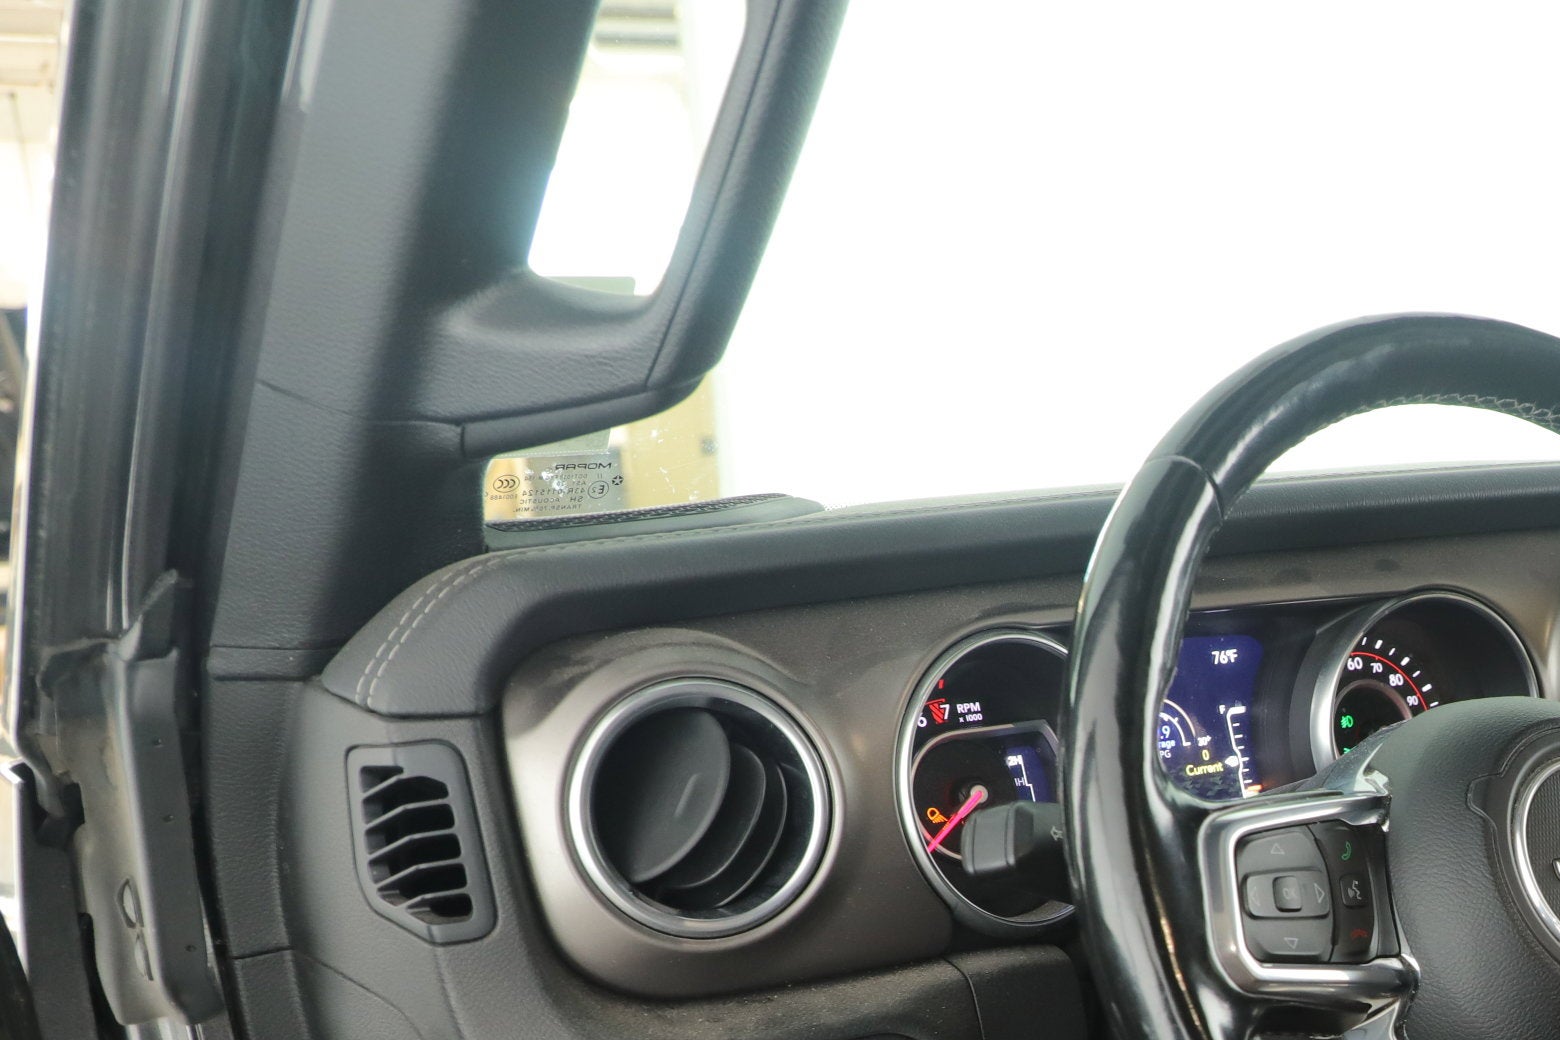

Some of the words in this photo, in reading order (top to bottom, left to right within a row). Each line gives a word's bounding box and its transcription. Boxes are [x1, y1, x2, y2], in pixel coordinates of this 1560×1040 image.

[1347, 657, 1363, 671] 60
[1370, 662, 1383, 673] 70
[1389, 673, 1404, 687] 80
[1406, 695, 1419, 707] 90
[940, 704, 950, 720] 7
[956, 702, 982, 713] RPM
[1219, 704, 1226, 715] F
[966, 713, 983, 722] 1000
[1185, 762, 1224, 777] Current
